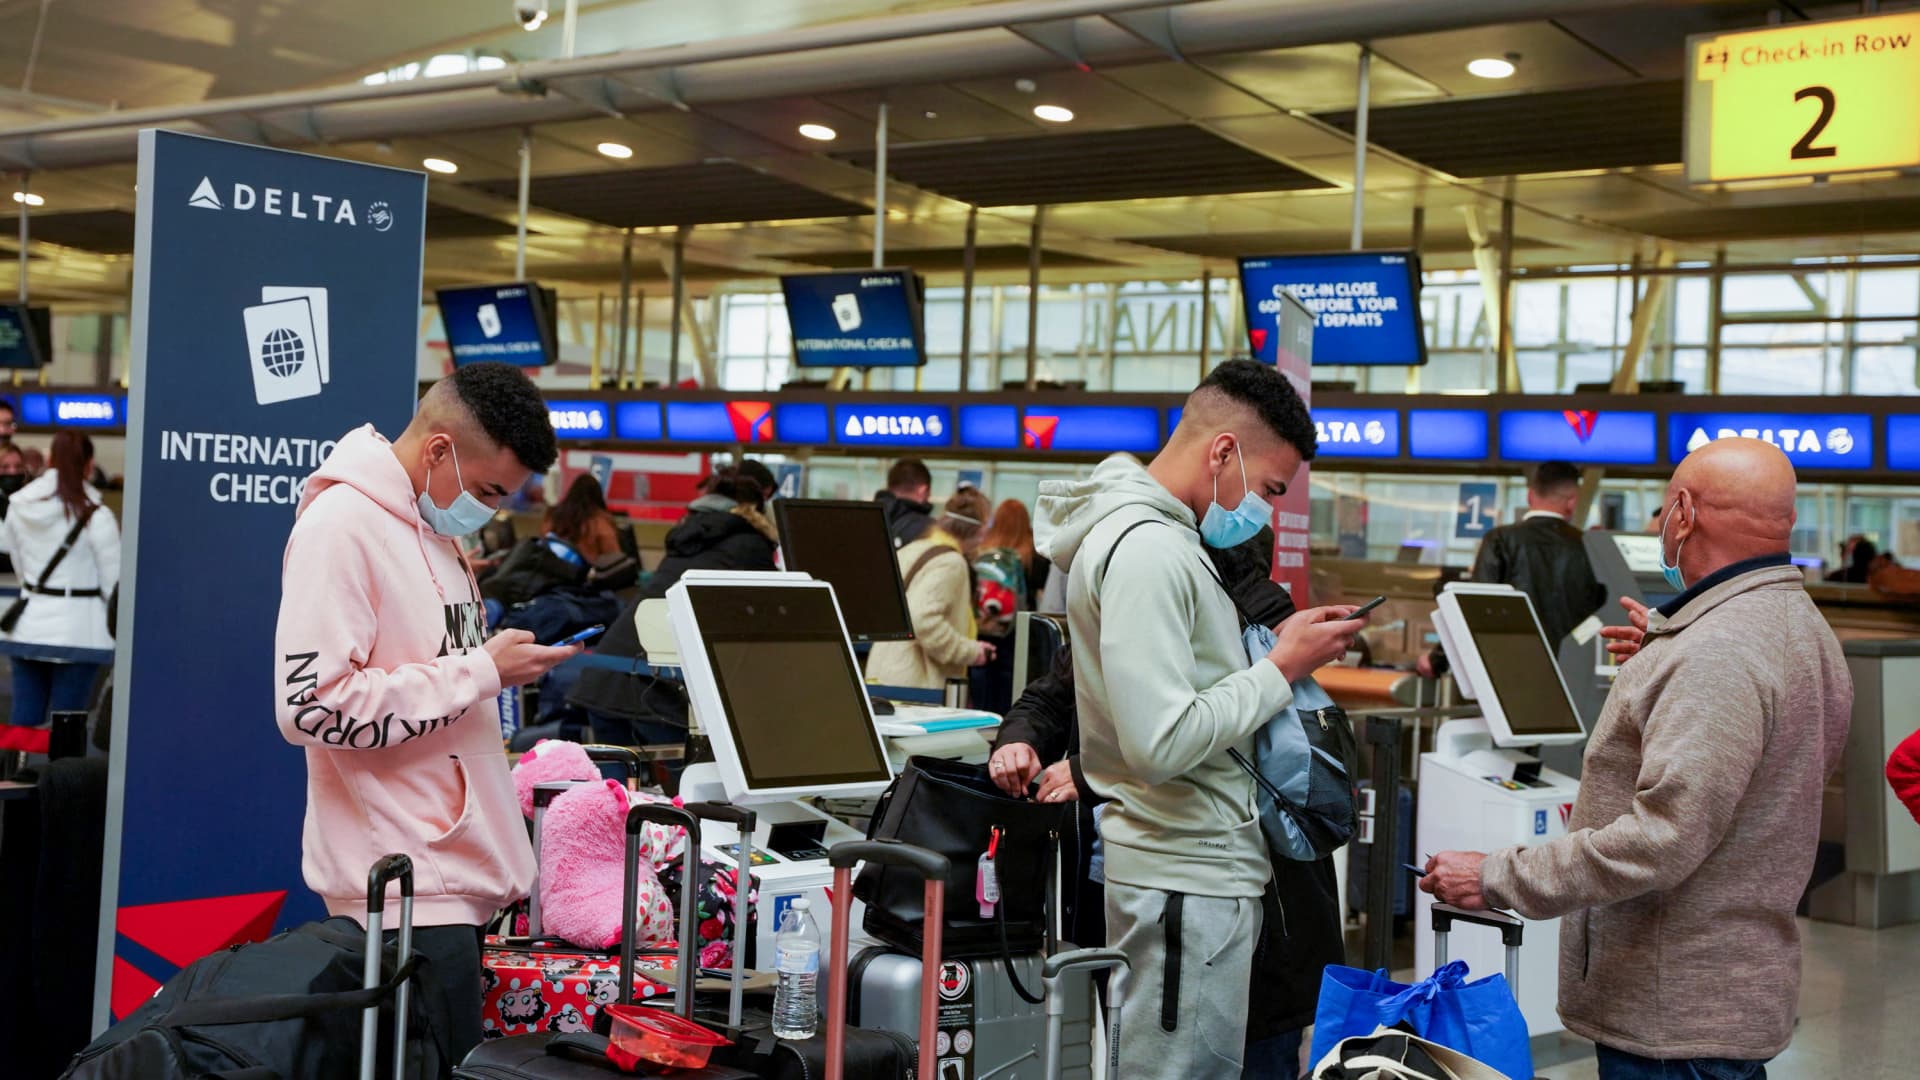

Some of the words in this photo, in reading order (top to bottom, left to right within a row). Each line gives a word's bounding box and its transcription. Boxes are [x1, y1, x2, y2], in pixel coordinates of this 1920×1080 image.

[1740, 36, 1844, 67] Check-in
[1854, 33, 1912, 53] Row
[1790, 85, 1837, 161] 2
[233, 183, 357, 226] DELTA
[1335, 281, 1378, 298] CLOSE
[1357, 297, 1399, 311] YOUR
[1322, 312, 1383, 328] DEPARTS
[863, 415, 925, 436] DELTA
[779, 472, 796, 498] 4
[1464, 494, 1483, 530] 1
